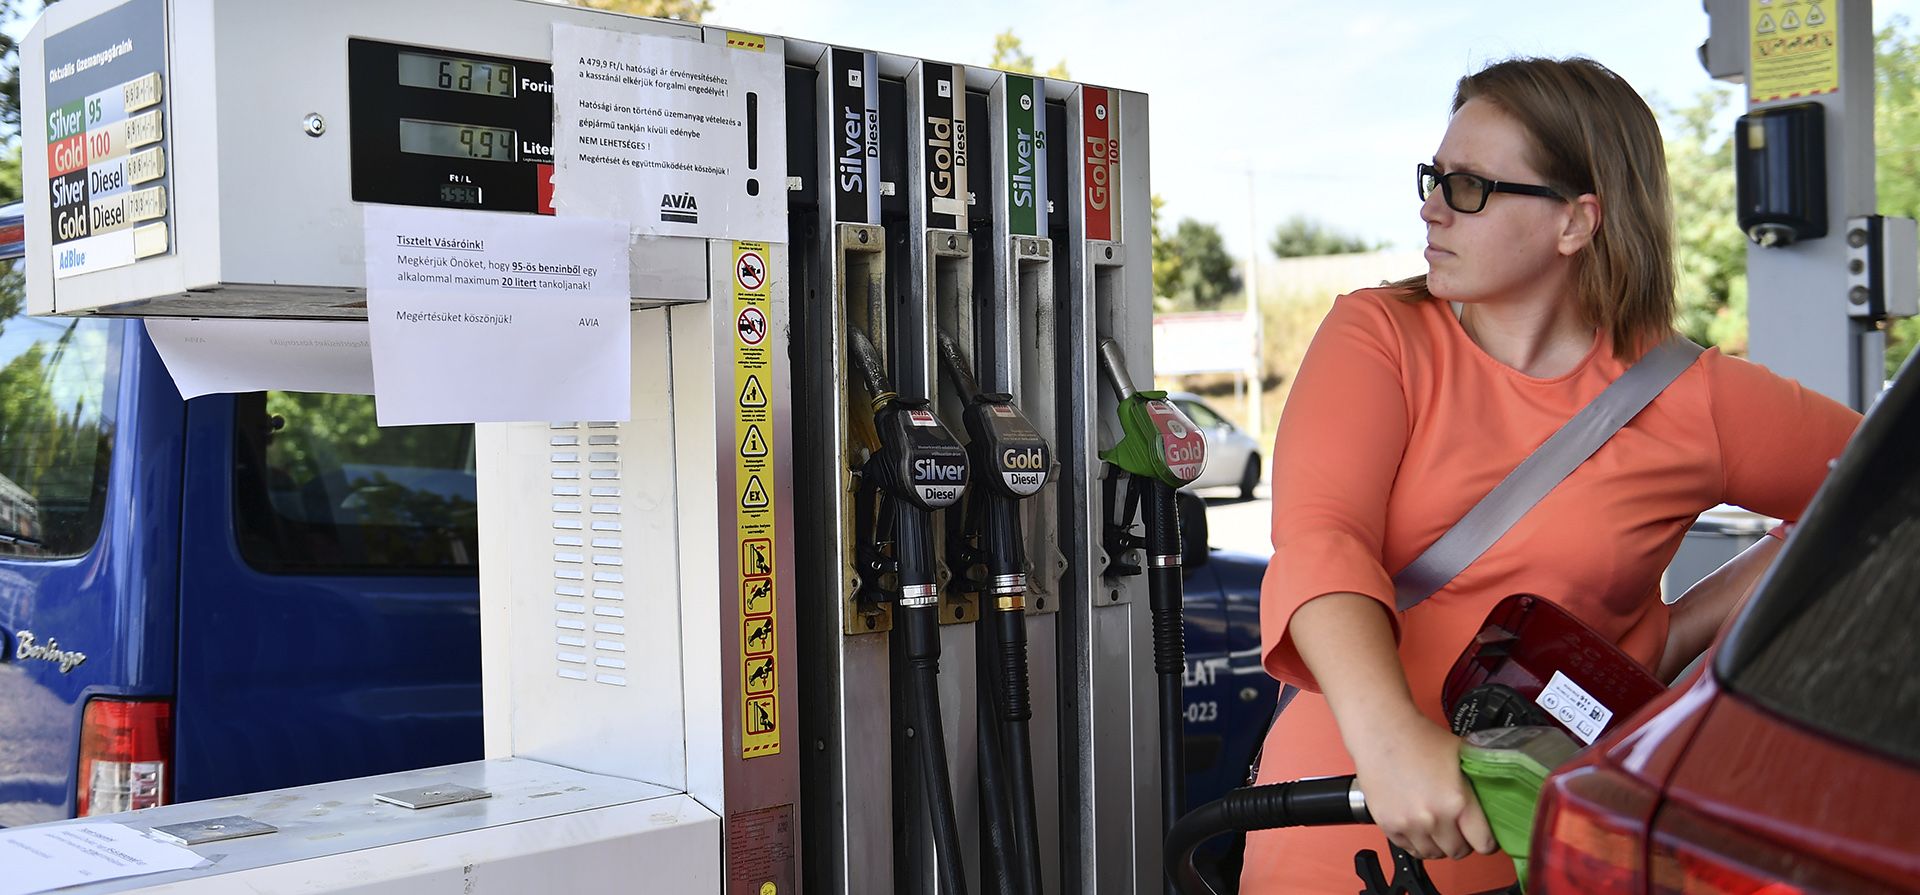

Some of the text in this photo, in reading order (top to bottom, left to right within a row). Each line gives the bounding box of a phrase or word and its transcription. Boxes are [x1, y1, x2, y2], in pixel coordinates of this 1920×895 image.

[438, 61, 511, 95] 6279
[579, 57, 728, 85] A 479,9 Ft/L hatósági ár érvényesítéséhez
[586, 71, 620, 83] kasszánál
[622, 76, 653, 87] elkérjük
[655, 79, 686, 90] forgalmi
[688, 85, 724, 97] engedélyét
[50, 108, 81, 141] Silver
[88, 98, 102, 124] 95
[579, 99, 612, 112] Hatósági
[613, 104, 631, 113] áron
[632, 106, 662, 116] történő
[664, 109, 704, 123] üzemanyag
[705, 115, 736, 126] vételezés
[579, 118, 701, 139] gépjármű tankján kívüli edénybe
[866, 108, 878, 158] Diesel
[1035, 130, 1045, 149] 95
[55, 136, 83, 172] Gold
[90, 131, 110, 159] 100
[460, 129, 511, 161] 9.94
[579, 136, 597, 145] NEM
[600, 138, 646, 150] LEHETSÉGES
[839, 106, 863, 193] Silver
[954, 119, 966, 167] Diesel
[1109, 139, 1118, 166] 100
[579, 154, 620, 164] Megértését
[622, 157, 630, 166] és
[631, 160, 693, 171] együttműködését
[694, 164, 726, 175] köszönjük
[928, 116, 952, 197] Gold
[1013, 127, 1032, 208] Silver
[450, 174, 459, 182] Ft
[466, 175, 472, 183] L
[1087, 136, 1107, 211] Gold
[52, 176, 84, 208] Silver
[92, 163, 123, 194] Diesel
[661, 192, 697, 210] AVIA
[58, 205, 87, 240] Gold
[93, 199, 125, 230] Diesel
[397, 235, 484, 250] Tisztelt Vásáróink!
[59, 248, 86, 270] AdBlue
[397, 255, 597, 277] Megkérjük Önöket, hogy 95-ös benzinből egy
[397, 272, 591, 291] alkalommal maximum 20 litert tankoljanak!
[396, 311, 599, 327] Megértésüket köszönjük! AVIA
[1003, 448, 1042, 469] Gold
[1167, 440, 1201, 462] Gold
[915, 458, 965, 480] Silver
[1011, 473, 1039, 485] Diesel
[1179, 465, 1196, 480] 100
[749, 491, 761, 501] EX
[925, 488, 956, 500] Diesel
[16, 630, 87, 674] Berlingo
